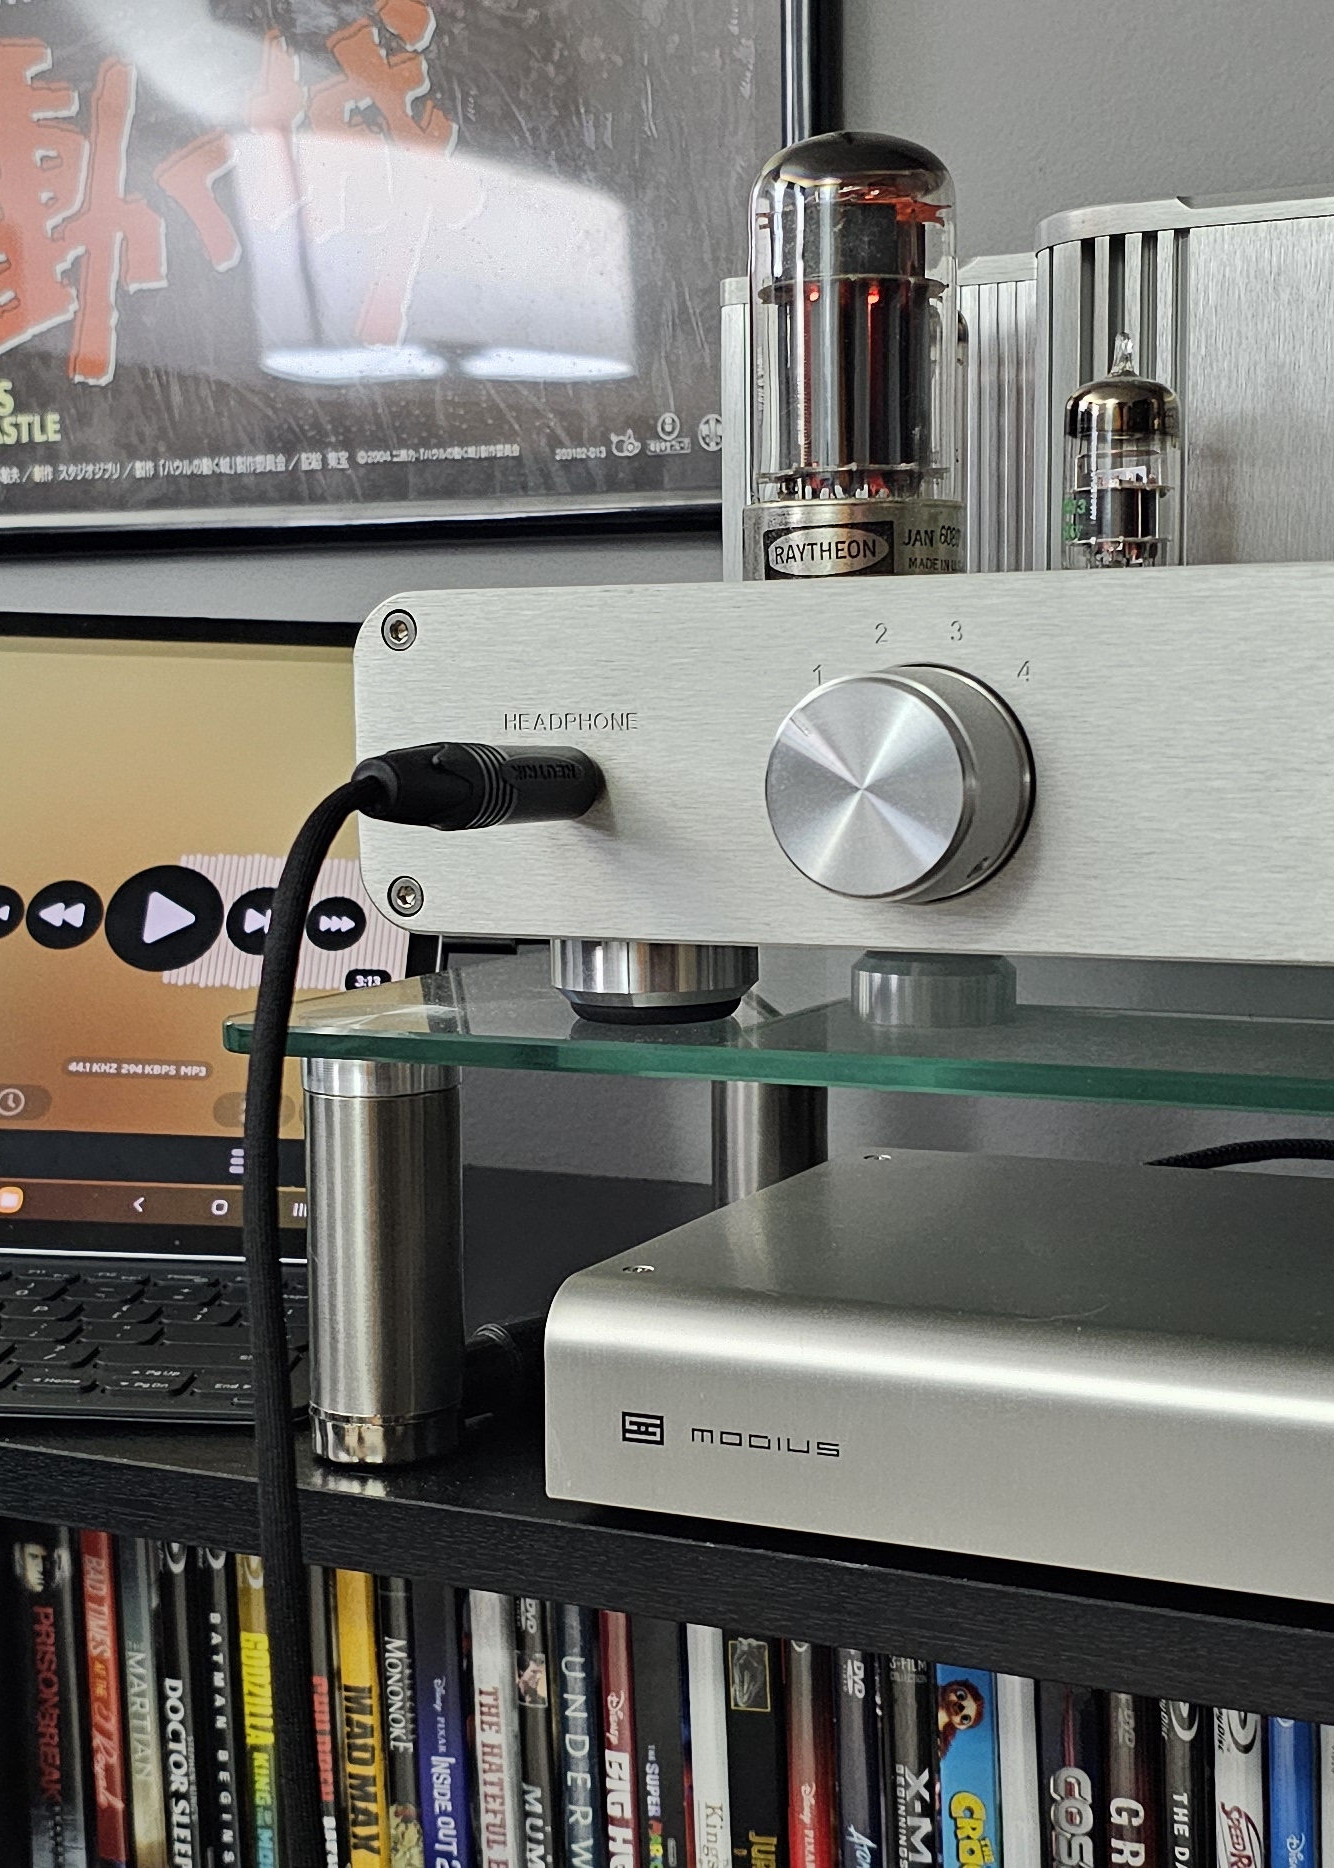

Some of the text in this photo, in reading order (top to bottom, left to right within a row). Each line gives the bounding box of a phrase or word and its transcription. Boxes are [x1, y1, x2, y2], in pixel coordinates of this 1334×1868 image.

[774, 539, 877, 565] RAYTHEON
[903, 528, 935, 548] JAN
[908, 556, 950, 571] MADE IN
[874, 622, 889, 644] 2
[949, 620, 964, 642] 3
[812, 664, 824, 685] 1
[1016, 660, 1033, 682] 4
[502, 711, 639, 733] HEADPHONE
[354, 975, 382, 988] 3:13
[68, 1061, 207, 1077] 44.1 KHZ 294 KBPS MP3
[83, 1553, 108, 1601] BAD
[87, 1600, 113, 1660] TIMES
[525, 1597, 538, 1634] DVD
[239, 1630, 275, 1746] GODZILLA
[384, 1636, 414, 1754] MONONOKE
[433, 1675, 447, 1713] Disney
[853, 1660, 866, 1699] DVD
[126, 1650, 154, 1782] MARTIAN
[478, 1686, 501, 1737] THE
[606, 1690, 626, 1745] Disney
[165, 1677, 189, 1799] DOCTOR
[209, 1612, 236, 1866] BATMAN BEGINS
[437, 1715, 448, 1753] PIXAR
[252, 1751, 271, 1807] KING
[343, 1683, 382, 1856] MAD MAX
[430, 1755, 457, 1815] INSIDE
[605, 1749, 632, 1819] BIG
[645, 1762, 662, 1818] SUPER
[481, 1740, 510, 1851] HATEFUL
[799, 1781, 816, 1825] Disney
[1172, 1792, 1190, 1839] THE
[436, 1816, 458, 1856] OUT
[980, 1837, 995, 1864] THE
